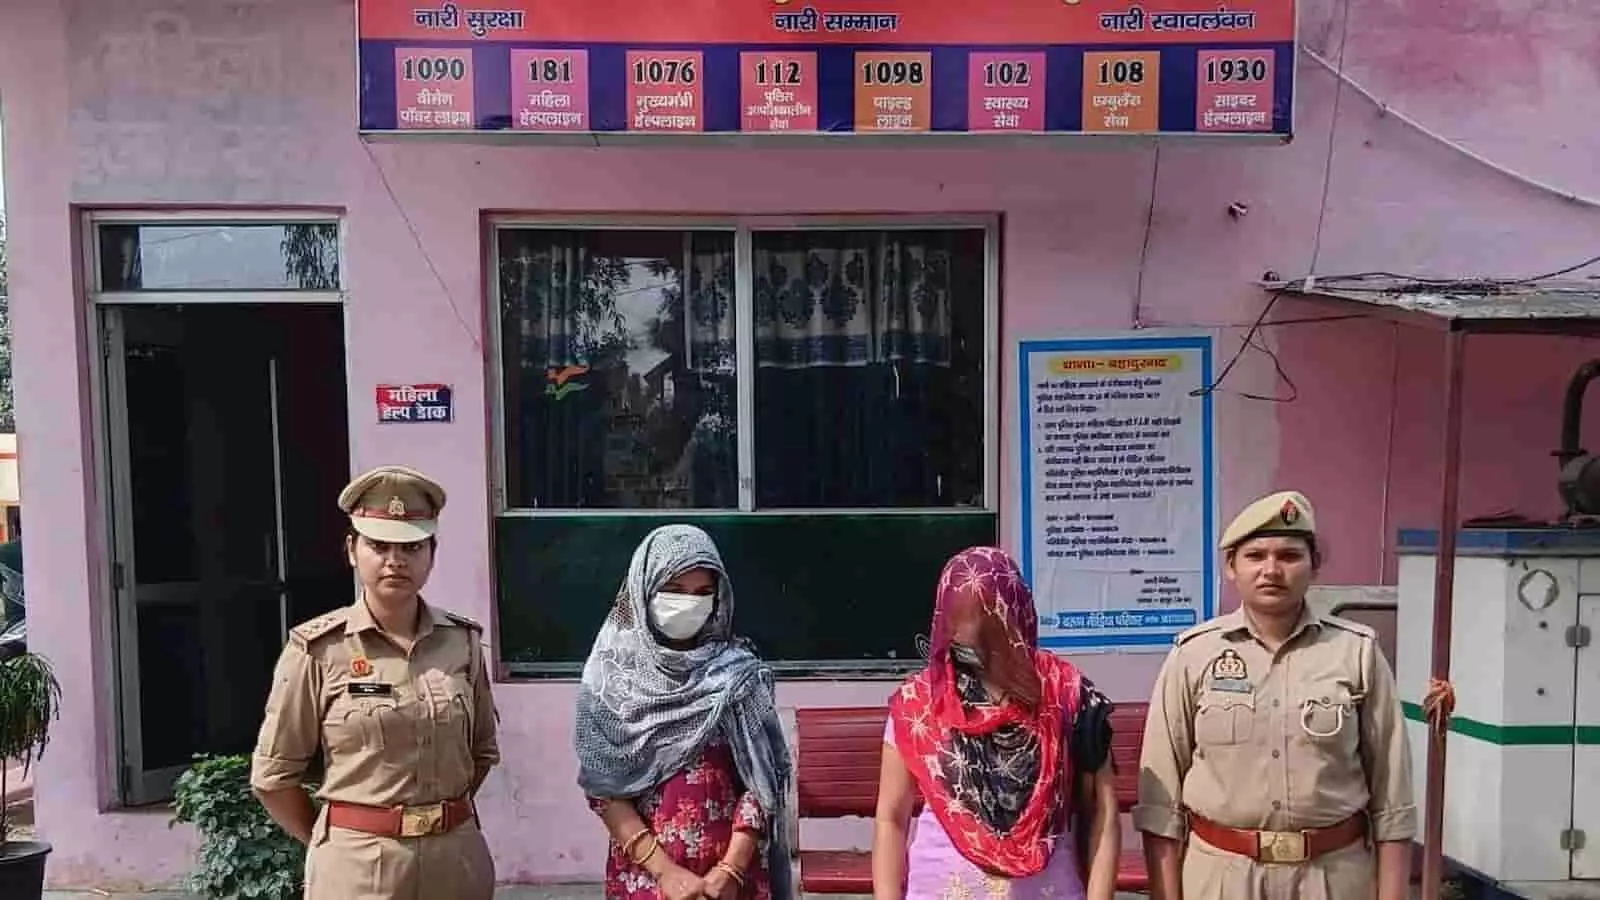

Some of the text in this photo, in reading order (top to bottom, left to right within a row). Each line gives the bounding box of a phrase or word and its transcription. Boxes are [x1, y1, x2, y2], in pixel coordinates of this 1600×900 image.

[414, 4, 525, 37] नारी सुरक्षा
[773, 7, 898, 32] नारी सम्मान
[1099, 7, 1145, 31] नारी
[402, 57, 466, 82] 1090
[527, 59, 574, 84] 181
[633, 59, 696, 85] 1076
[755, 60, 803, 86] 112
[861, 60, 924, 86] 1098
[983, 60, 1031, 86] 102
[1097, 60, 1144, 85] 108
[1204, 58, 1267, 84] 1930
[528, 91, 570, 107] महिला
[992, 112, 1019, 127] सेवा
[388, 386, 438, 402] महिला
